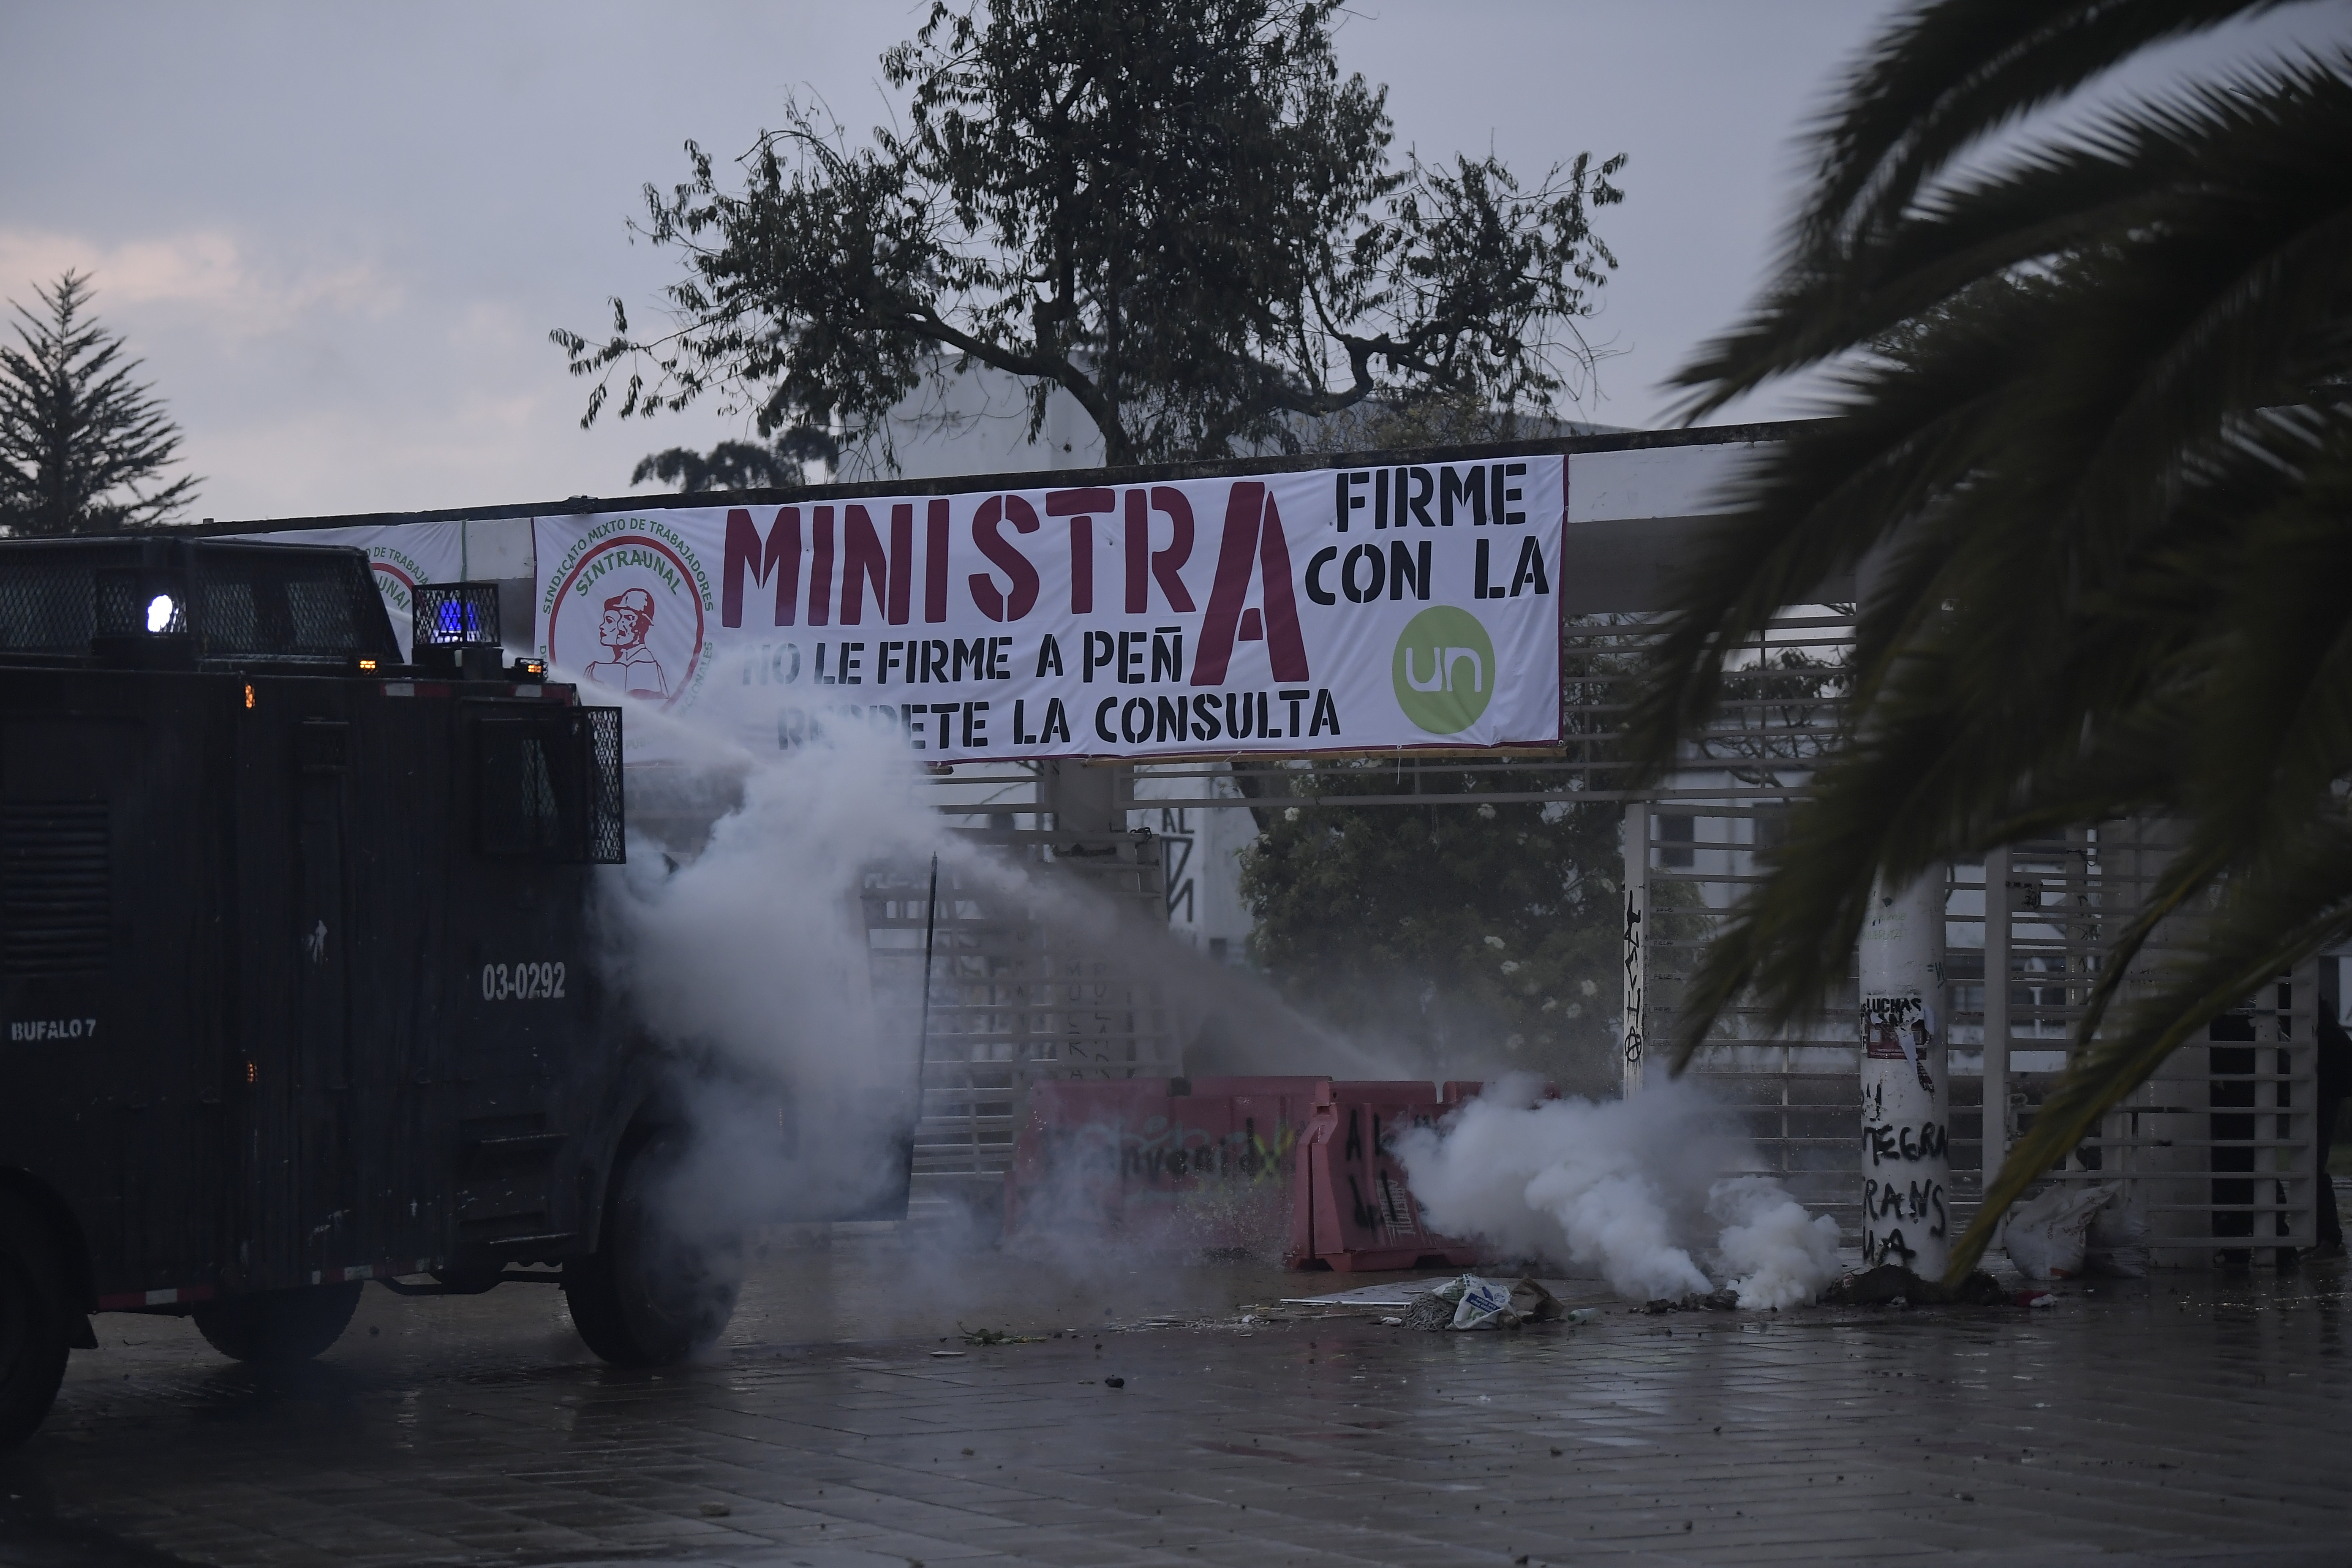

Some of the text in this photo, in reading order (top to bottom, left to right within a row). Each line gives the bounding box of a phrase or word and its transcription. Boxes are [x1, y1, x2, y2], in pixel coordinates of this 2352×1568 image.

[1336, 463, 1527, 532] FIRME
[374, 547, 429, 585] DE TRABAJA
[543, 518, 714, 615] SINDICATO MIXTO DE TRABAJADORES
[576, 549, 681, 597] SINTRAUNAL
[722, 481, 1309, 686] MINISTRA
[1305, 536, 1550, 606] CON LA
[743, 642, 801, 685] NO
[814, 642, 864, 685] LE
[877, 637, 1013, 684] FIRME
[1035, 634, 1063, 678] A
[1013, 697, 1070, 745] LA
[1095, 689, 1341, 743] CONSULTA
[482, 961, 565, 1001] 03-0292
[1867, 998, 1922, 1013] LUCHAS
[11, 1019, 96, 1041] BUFALO 7
